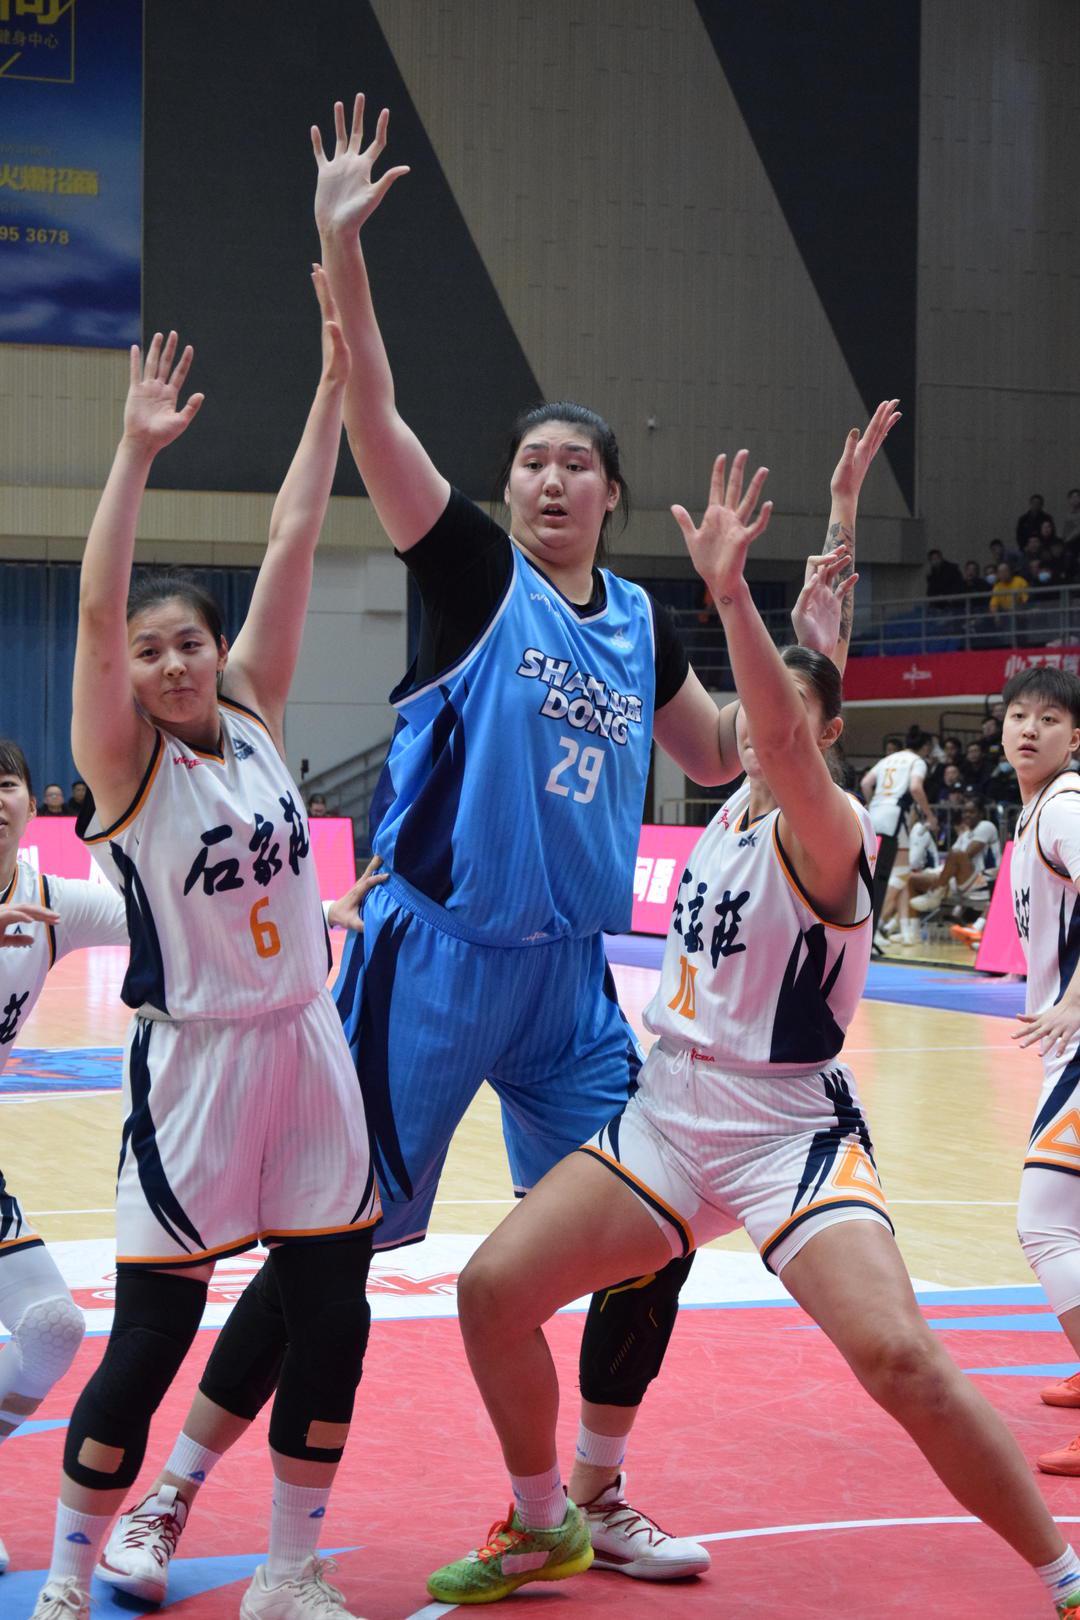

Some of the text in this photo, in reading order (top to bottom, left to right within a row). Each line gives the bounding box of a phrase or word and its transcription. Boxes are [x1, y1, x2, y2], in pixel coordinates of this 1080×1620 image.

[26, 227, 70, 245] 3678
[516, 647, 609, 707] SHAN
[539, 686, 629, 745] DONG
[544, 736, 605, 804] 29
[250, 896, 281, 958] 6
[667, 955, 698, 1020] 10
